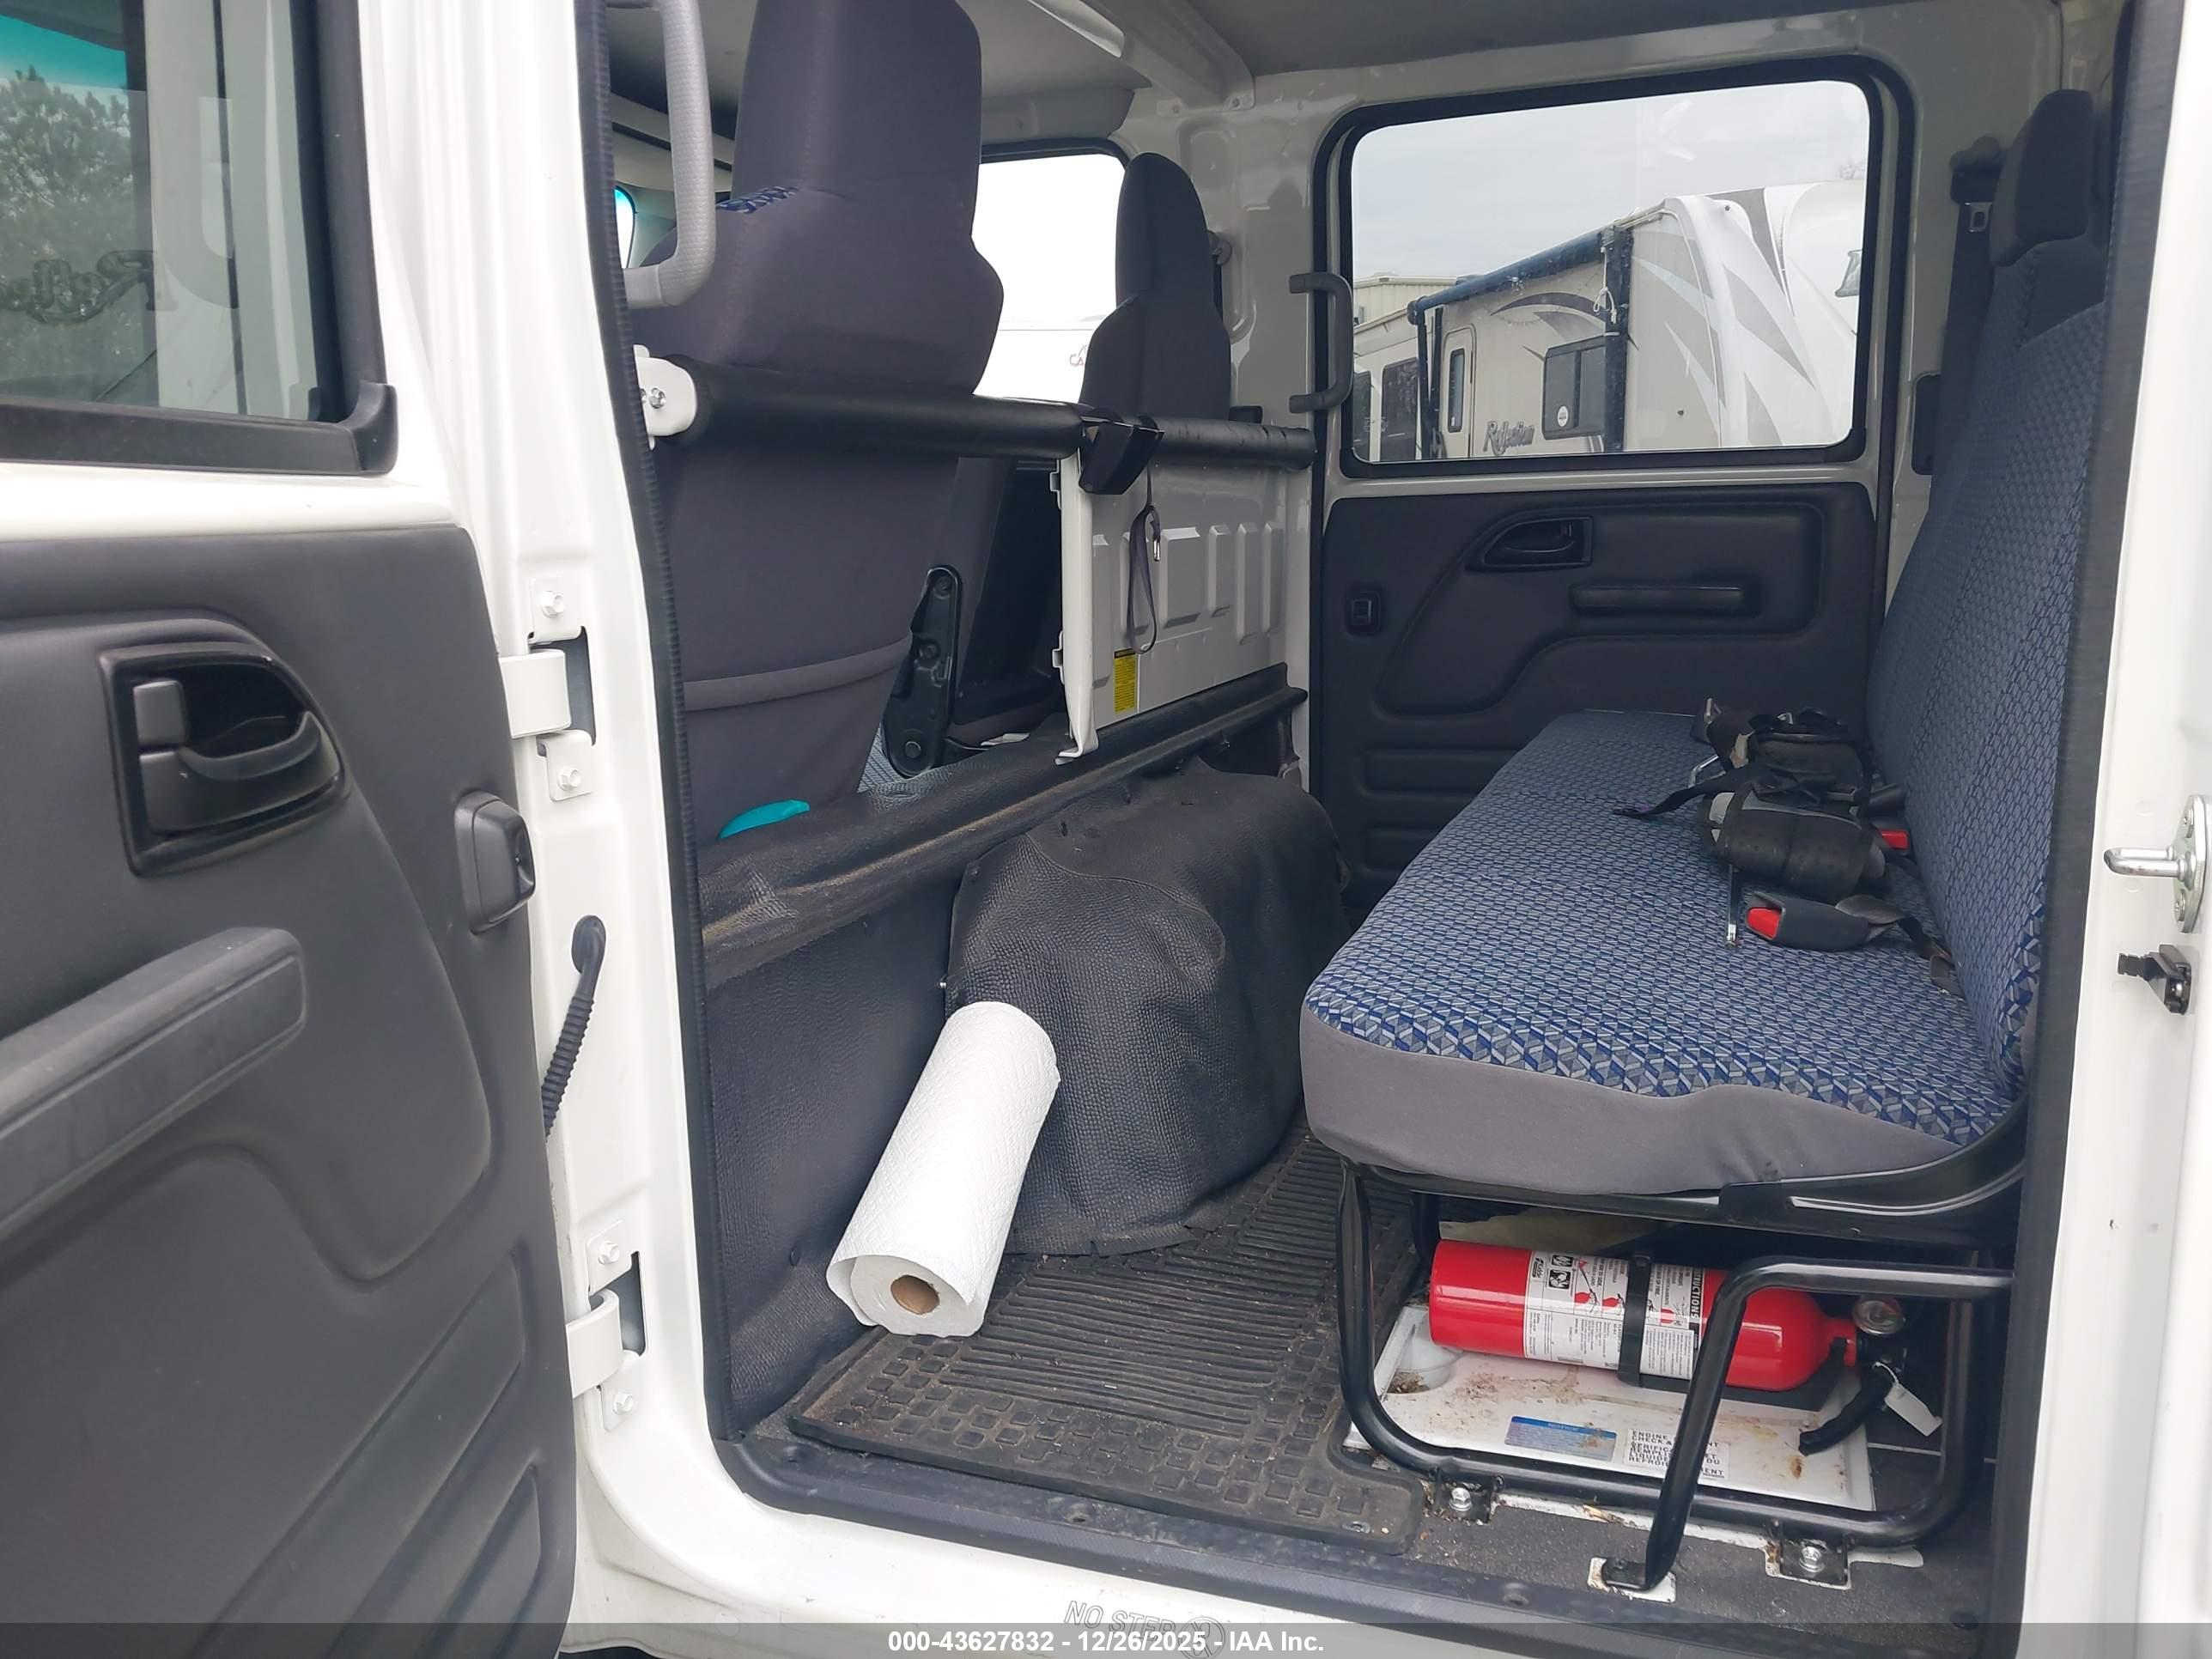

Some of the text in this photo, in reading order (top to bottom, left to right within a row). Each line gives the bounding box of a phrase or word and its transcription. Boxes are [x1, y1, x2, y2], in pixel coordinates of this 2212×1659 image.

[1483, 420, 1534, 456] Reflection
[1632, 1430, 1668, 1440] ENGINE
[1632, 1435, 1663, 1444] CHECK
[1063, 1600, 1104, 1628] NO
